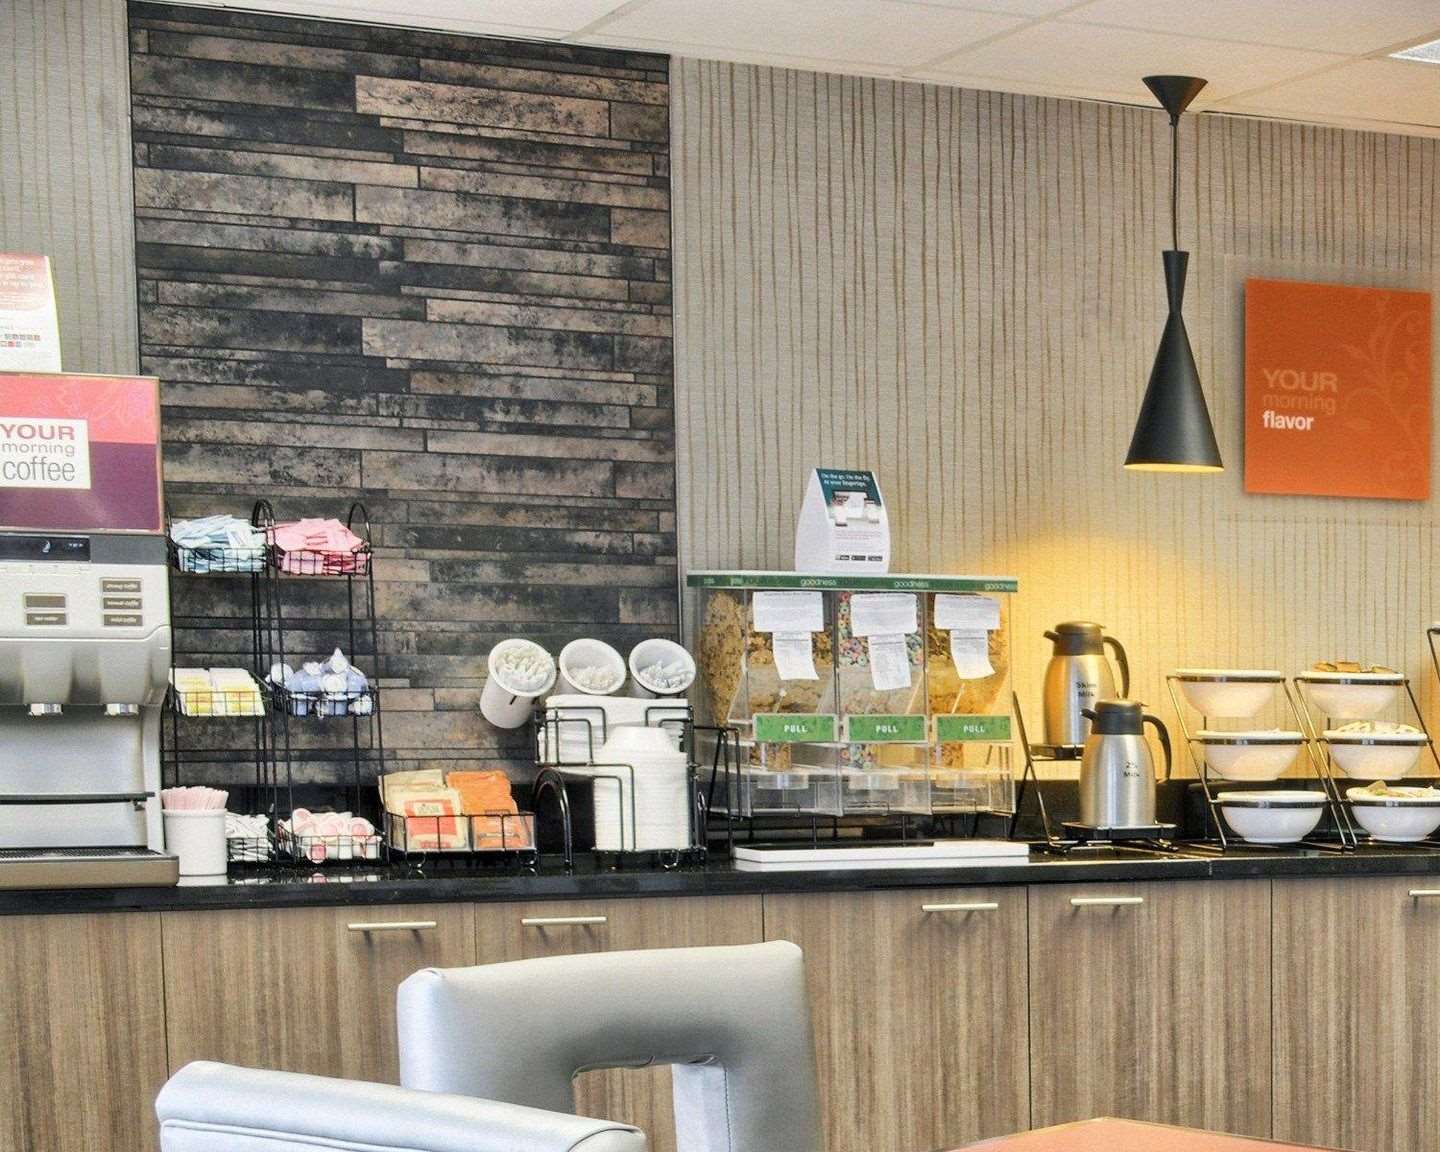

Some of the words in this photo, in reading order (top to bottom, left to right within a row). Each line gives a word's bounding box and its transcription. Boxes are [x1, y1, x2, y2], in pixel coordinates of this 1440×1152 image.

[1263, 368, 1338, 392] YOUR
[1263, 393, 1337, 415] morning
[1262, 410, 1314, 431] flavor
[0, 424, 75, 440] YOUR
[2, 443, 75, 457] morning
[3, 456, 76, 481] coffee
